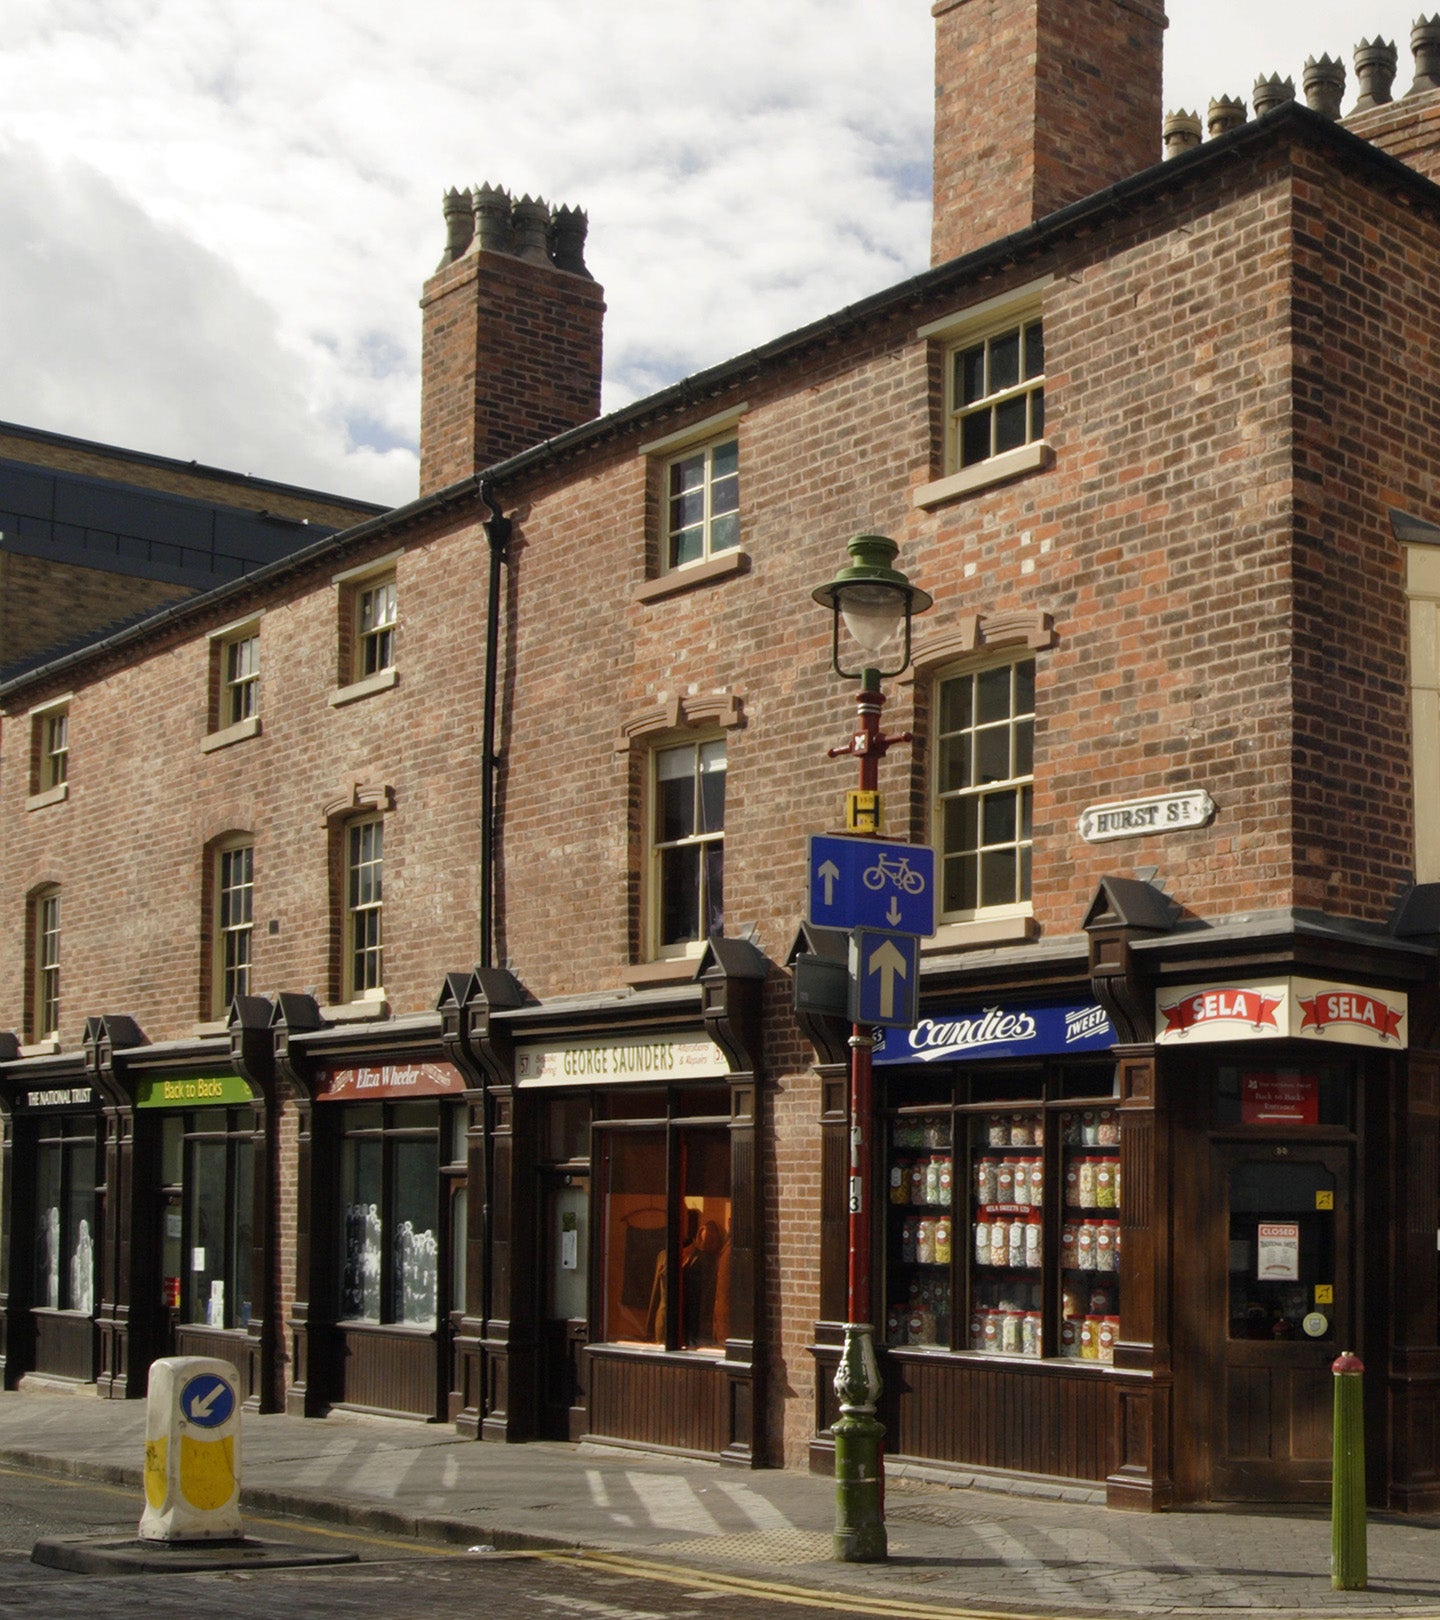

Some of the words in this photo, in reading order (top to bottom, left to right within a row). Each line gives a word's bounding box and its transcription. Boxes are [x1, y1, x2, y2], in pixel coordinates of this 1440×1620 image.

[853, 795, 879, 827] H
[1096, 805, 1159, 833] HURST
[1192, 993, 1248, 1020] SELA
[1327, 996, 1377, 1024] SELA
[908, 1005, 1037, 1050] Candies
[1066, 1009, 1107, 1040] SWEETS
[563, 1047, 608, 1076] GEORGE
[612, 1042, 675, 1074] SAUNDERS
[163, 1080, 184, 1100] Back
[185, 1082, 195, 1098] to
[197, 1078, 223, 1098] Backs
[356, 1067, 380, 1089] Eliza
[381, 1064, 420, 1087] Wheeler
[28, 1091, 40, 1106] THE
[39, 1089, 71, 1106] NATIONAL
[71, 1087, 92, 1104] TRUST
[1262, 1228, 1295, 1236] CLOSED
